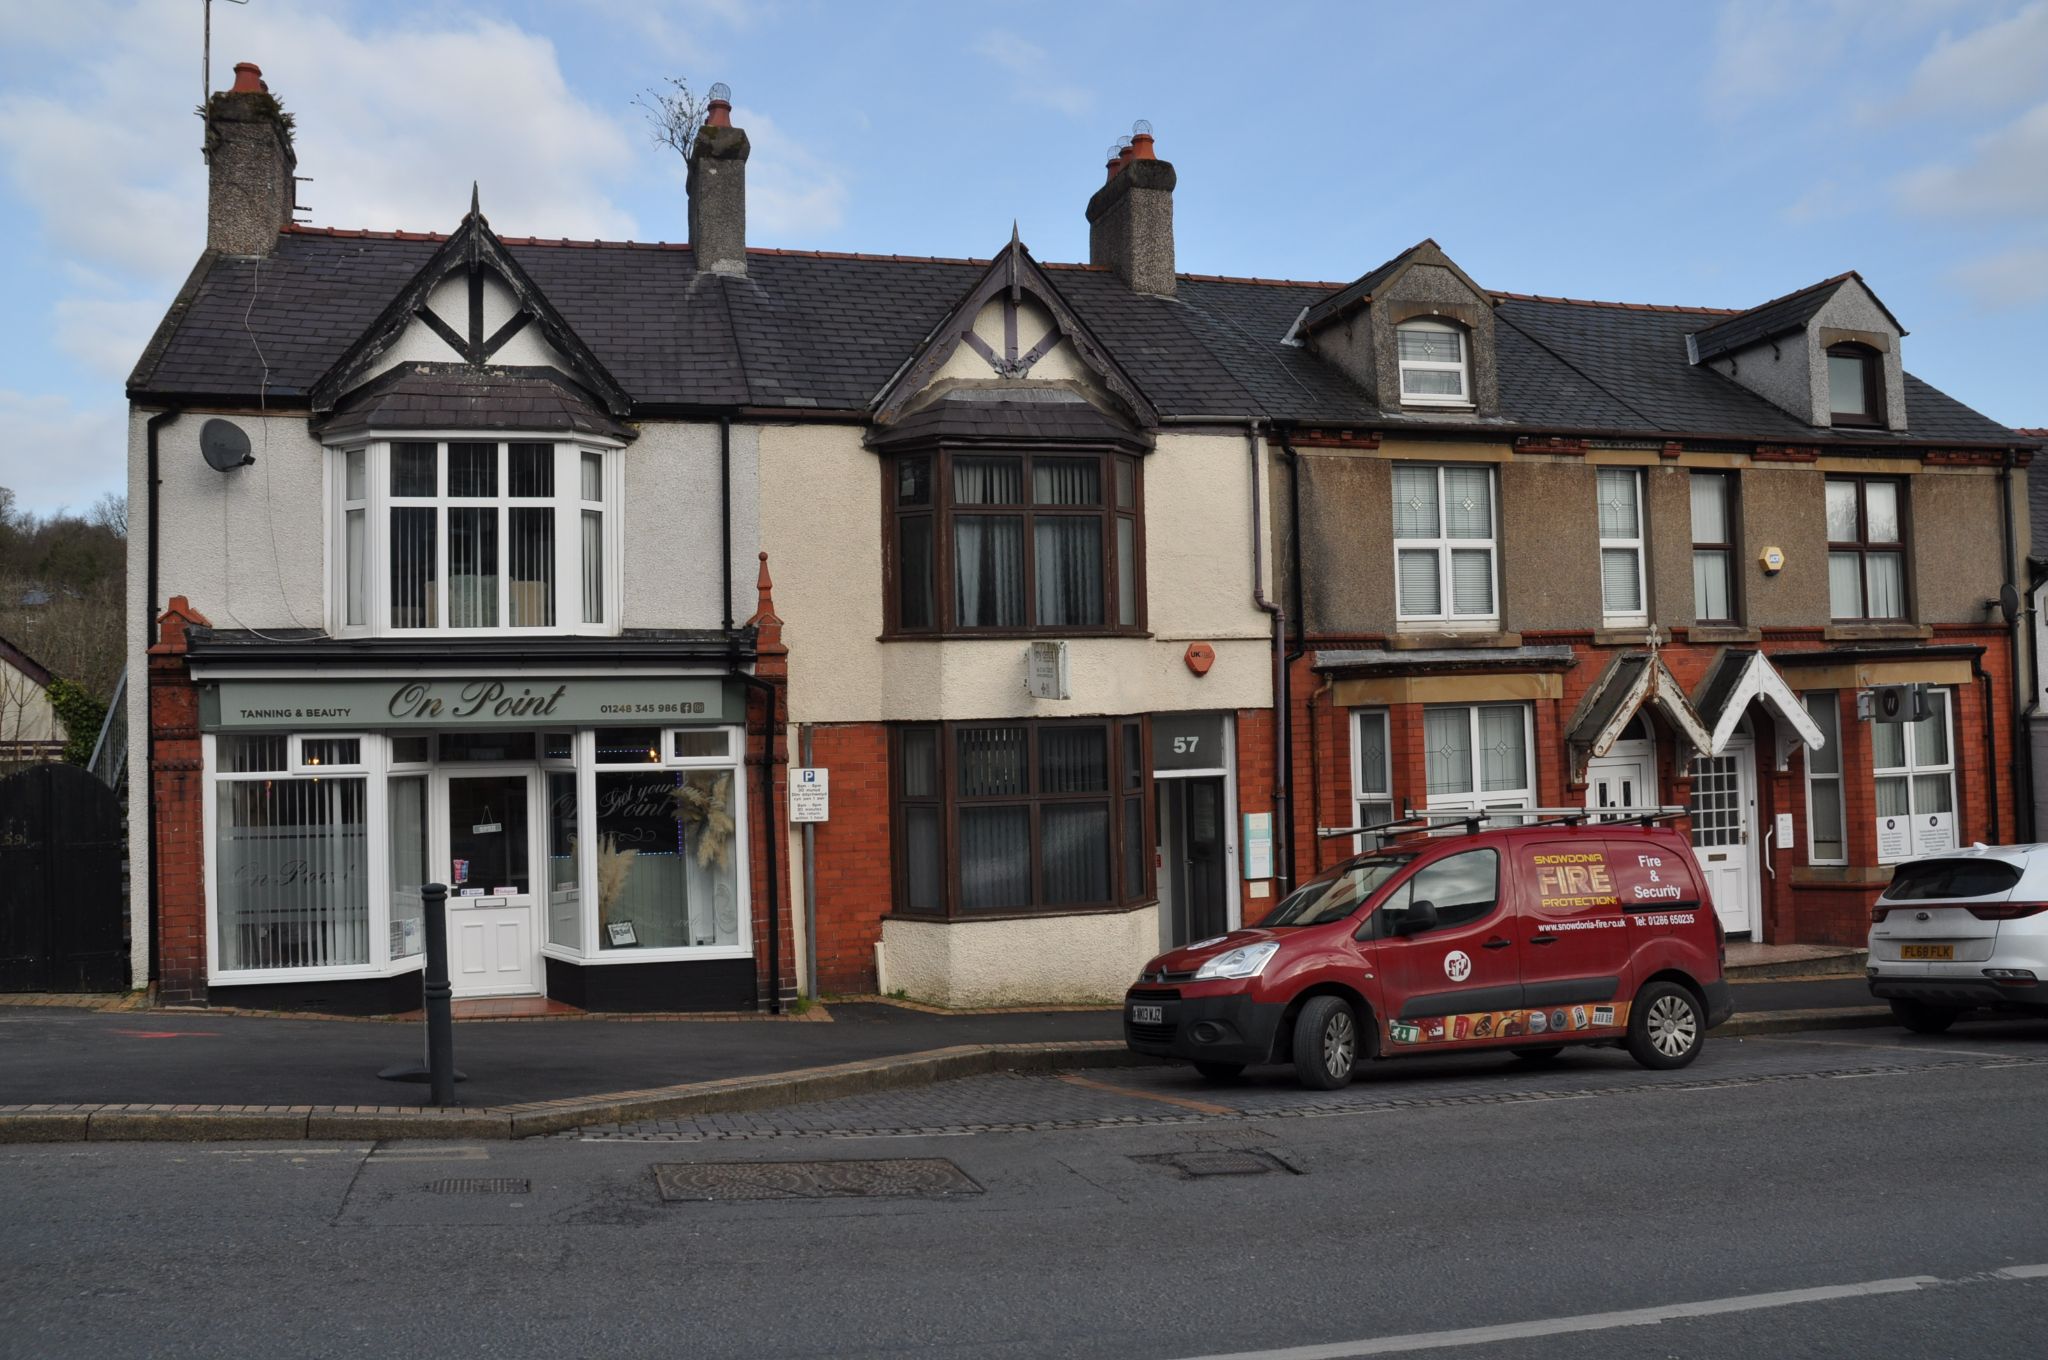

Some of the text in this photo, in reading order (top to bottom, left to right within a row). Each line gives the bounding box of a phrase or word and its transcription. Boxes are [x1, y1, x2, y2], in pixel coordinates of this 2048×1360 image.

[388, 681, 567, 719] On Point
[240, 708, 351, 718] TANNING & BEAUTY
[600, 703, 632, 714] 01248
[635, 703, 655, 713] 345
[658, 703, 678, 713] 986
[1174, 736, 1199, 753] 57
[1534, 854, 1602, 864] SNOWDONIA
[1638, 855, 1662, 867] Fire
[1536, 864, 1612, 896] FIRE
[1650, 870, 1660, 882] &
[1634, 884, 1681, 900] Security
[1542, 896, 1614, 907] PROTECTION
[1538, 919, 1626, 931] www.snowdonia-fire.co.uk
[1648, 915, 1669, 925] 01286
[1670, 914, 1695, 924] 650235
[1931, 946, 1950, 957] FLK
